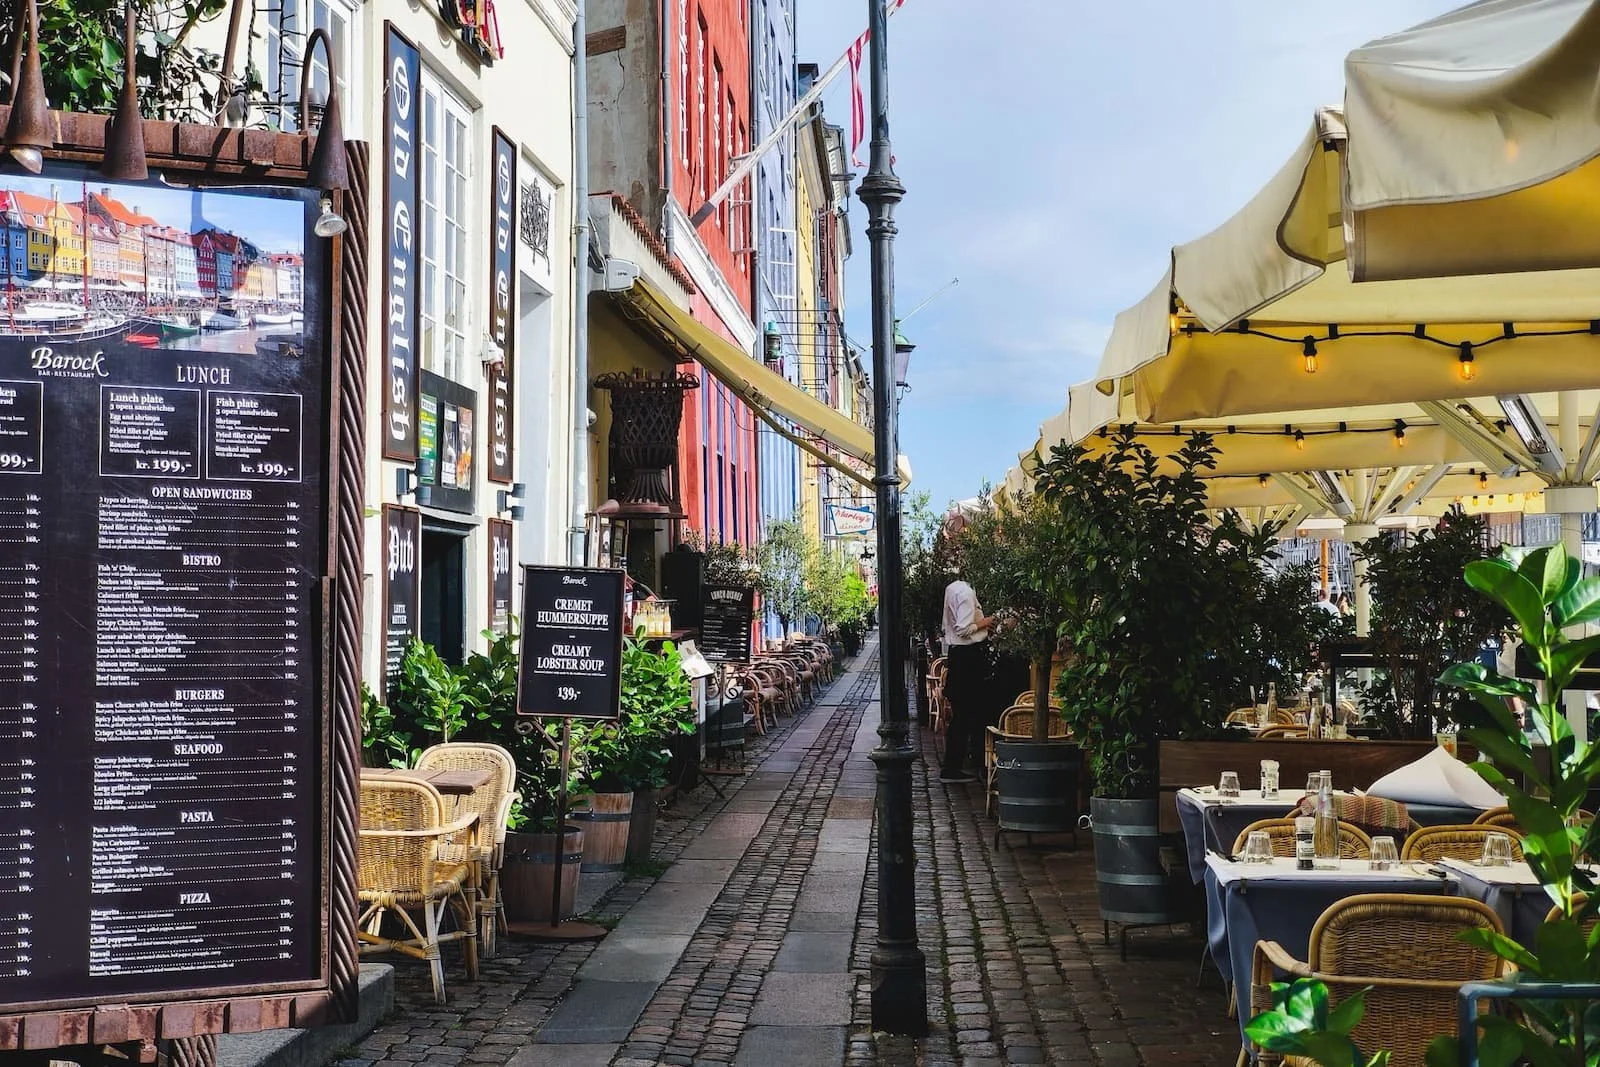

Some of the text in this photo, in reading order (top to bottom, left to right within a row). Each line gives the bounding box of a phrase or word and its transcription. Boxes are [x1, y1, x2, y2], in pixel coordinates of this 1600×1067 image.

[390, 200, 411, 442] English
[31, 346, 109, 377] Barock
[494, 269, 508, 467] Enlish
[177, 366, 231, 385] LUNCH
[110, 392, 164, 405] Lunch plate
[216, 398, 259, 409] Fish plate
[134, 404, 176, 412] sandwiches
[239, 409, 278, 417] sandwiches
[136, 459, 192, 472] kr. 199,-
[241, 464, 294, 476] kr. 199,-
[152, 486, 253, 500] OPEN SANDWICHES
[388, 526, 413, 580] Pub
[182, 555, 222, 566] BISTRO
[555, 598, 593, 612] CREMET
[537, 611, 609, 626] HUMMERSUPPE
[552, 644, 592, 658] CREAMY
[537, 657, 605, 672] LOBSTER SOUP
[176, 690, 224, 700] BURGERS
[558, 687, 581, 701] 139,-
[174, 744, 224, 754] SEAFOOD
[180, 811, 214, 823] PASTA
[180, 892, 211, 904] PIZZA
